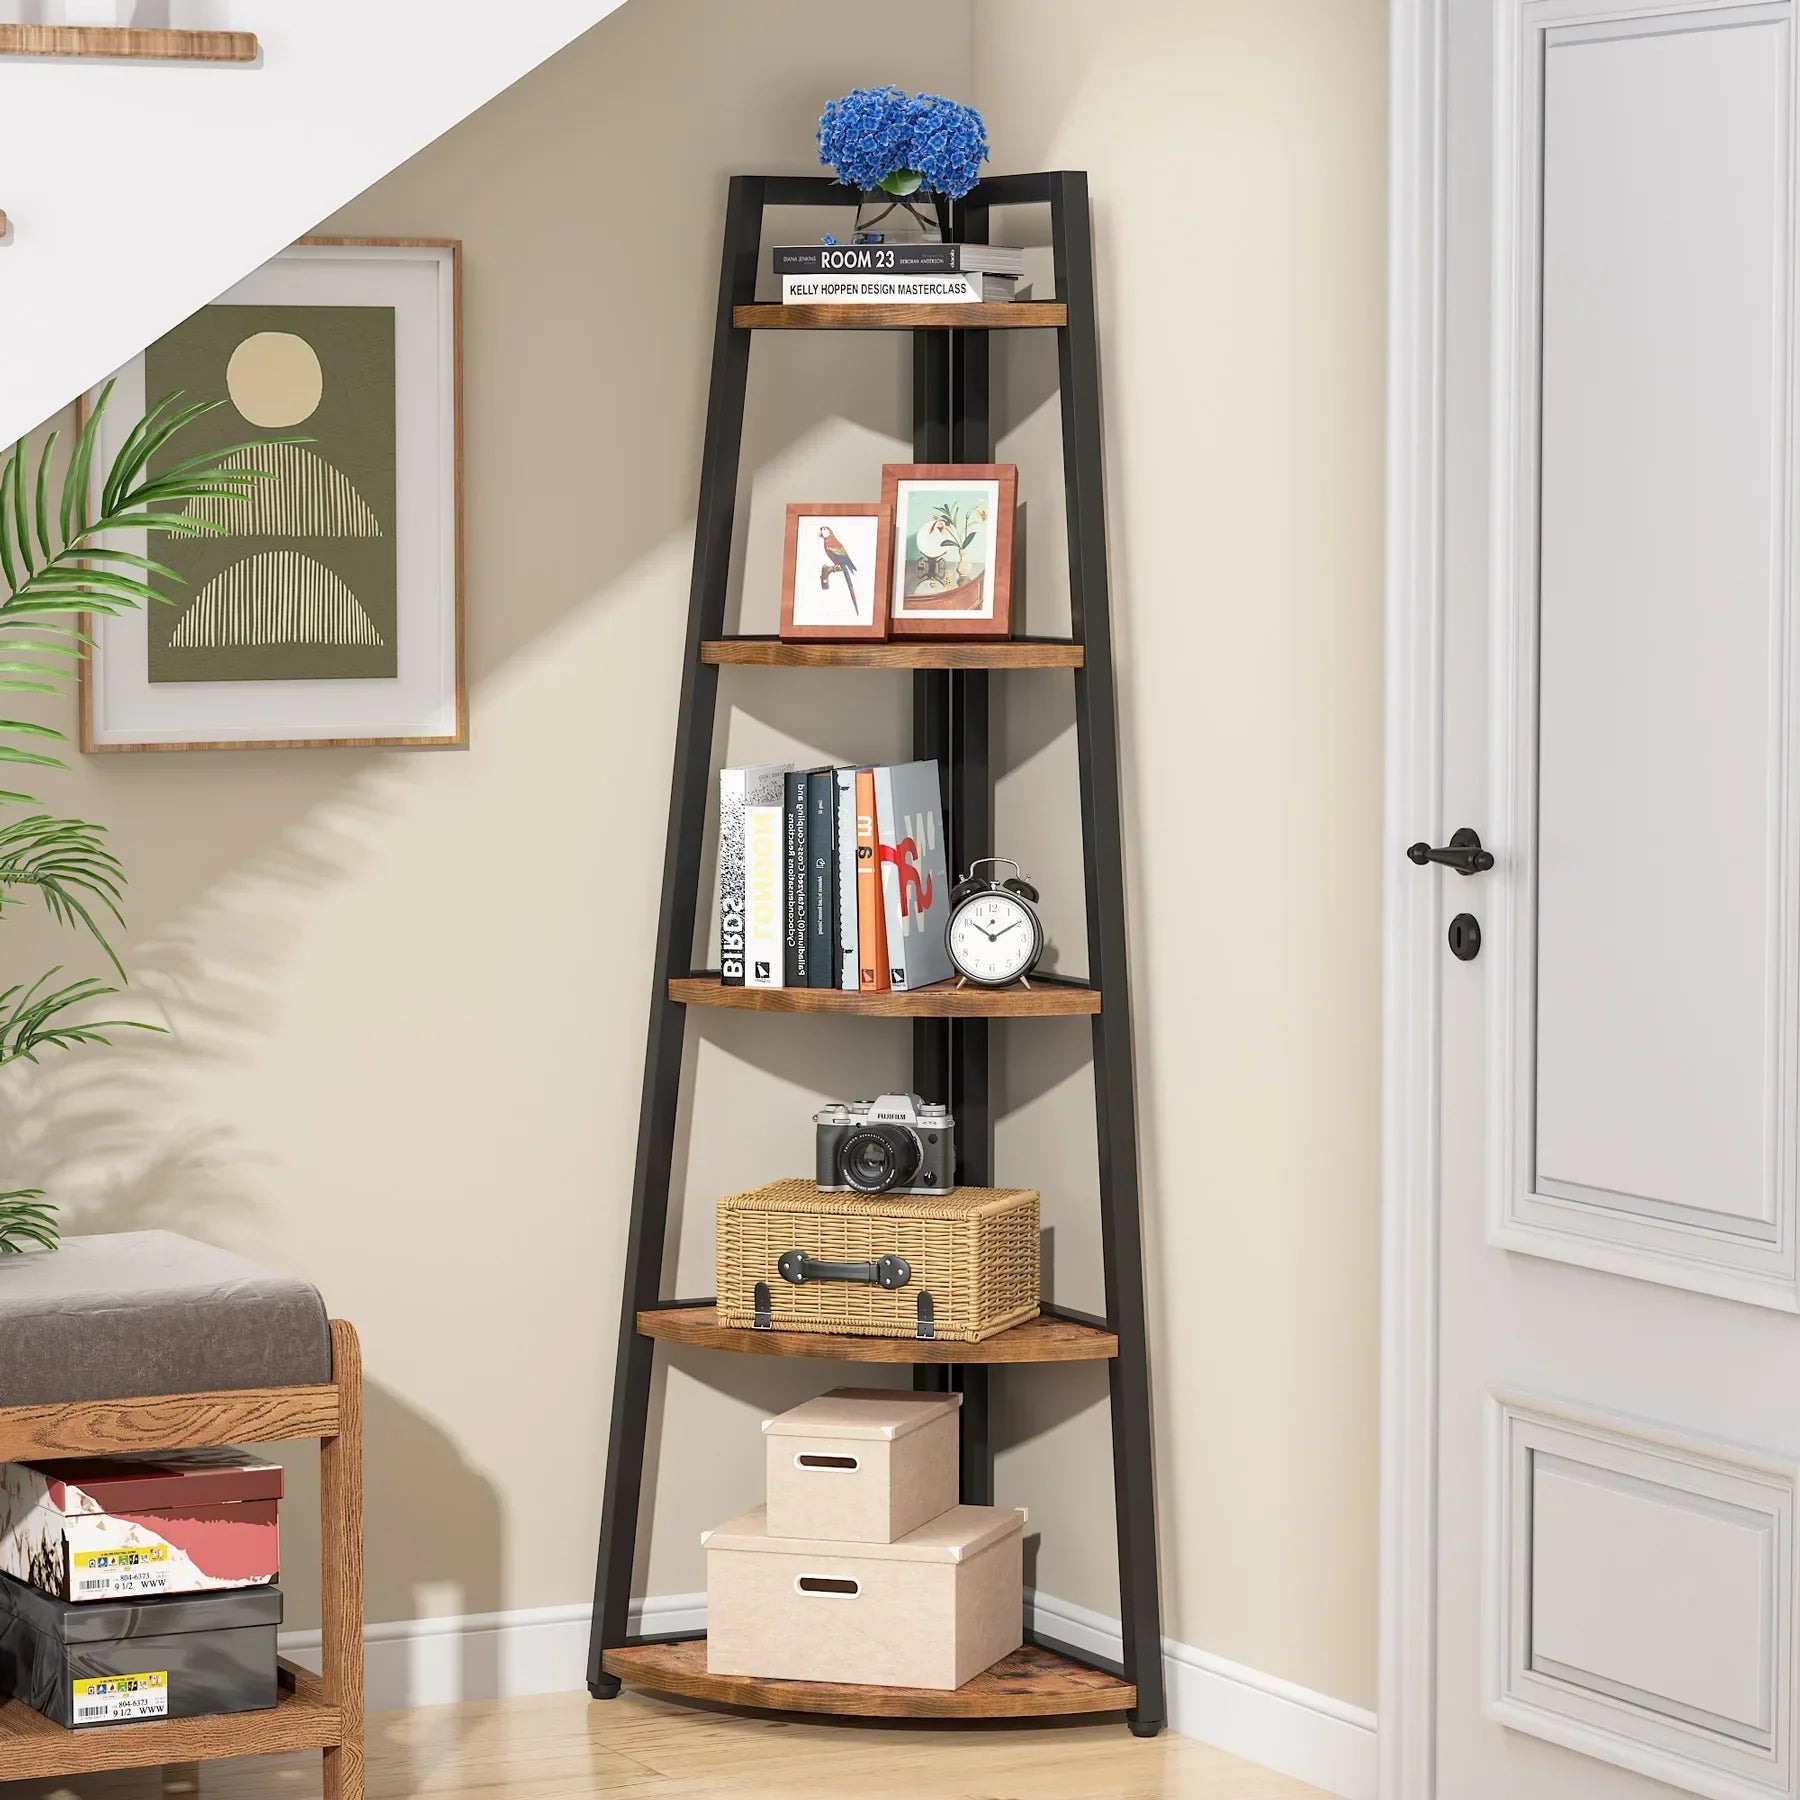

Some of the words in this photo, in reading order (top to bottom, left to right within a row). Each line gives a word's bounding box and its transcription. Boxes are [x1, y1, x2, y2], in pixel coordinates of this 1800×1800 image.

[821, 250, 872, 269] ROOM
[875, 250, 895, 268] 23
[790, 284, 819, 295] KELLY
[821, 284, 859, 295] HOPPEN
[861, 283, 895, 295] DESIGN
[898, 283, 967, 295] MASTERCLASS
[975, 907, 983, 917] 11
[988, 904, 998, 913] 12
[964, 918, 973, 927] 10
[958, 933, 964, 942] 9
[1020, 934, 1027, 943] 3
[962, 948, 969, 957] 8
[974, 959, 980, 968] 7
[1005, 959, 1012, 968] 5
[989, 964, 995, 973] 6
[877, 1113, 906, 1121] FUJIFILM
[120, 1573, 150, 1582] 804-6373
[114, 1582, 120, 1591] 9
[122, 1582, 133, 1591] 1/2
[141, 1579, 166, 1588] WWW
[118, 1699, 148, 1708] 804-6373
[113, 1710, 118, 1718] 9
[120, 1708, 132, 1717] 1/2
[139, 1705, 165, 1714] WWW
